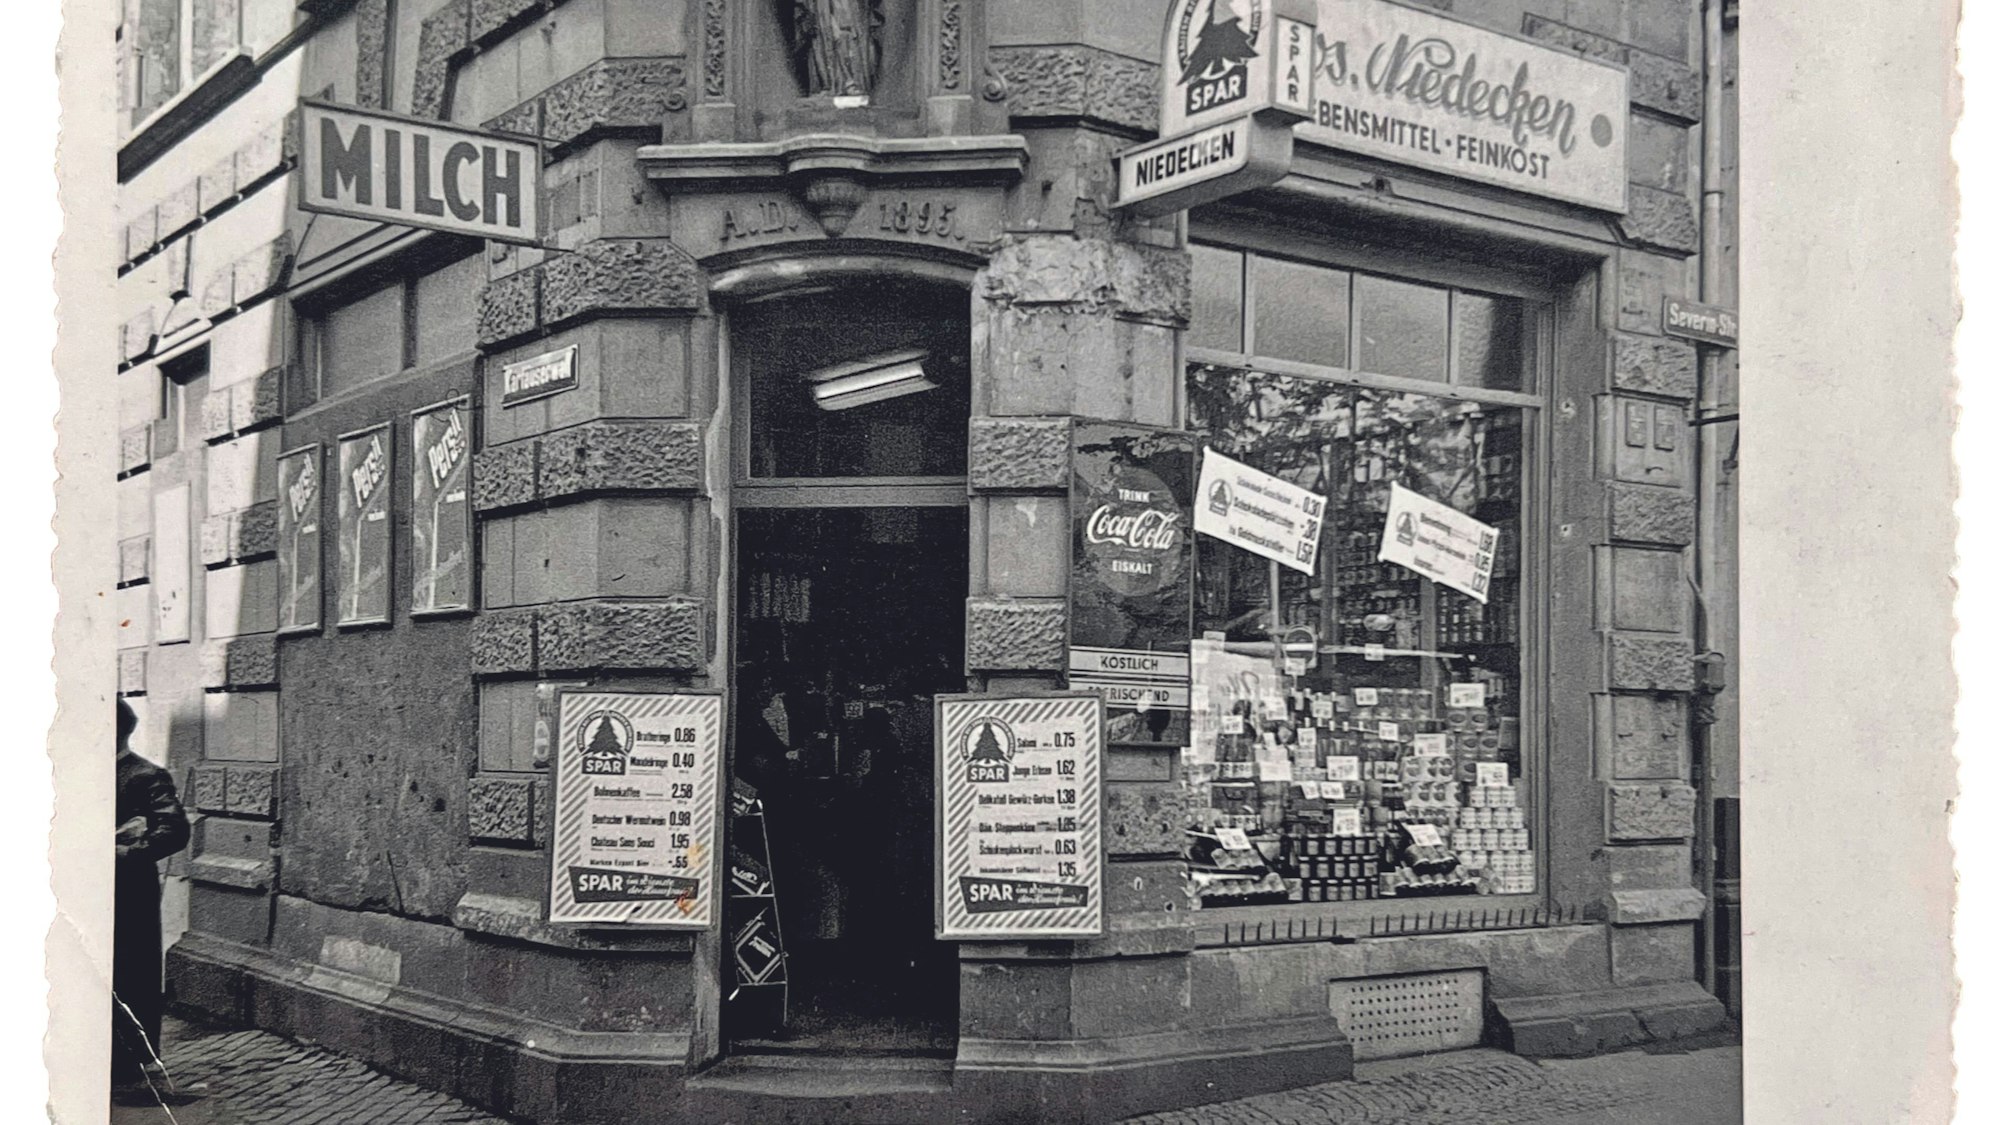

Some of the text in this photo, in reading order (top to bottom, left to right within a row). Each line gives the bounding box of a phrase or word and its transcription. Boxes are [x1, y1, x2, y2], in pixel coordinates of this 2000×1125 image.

[1287, 24, 1300, 103] SPAR
[1190, 74, 1241, 111] SPAR
[1366, 33, 1576, 158] Niedecken
[1313, 100, 1550, 179] BENSMITTEL FEINKOST
[1136, 131, 1235, 187] NIEDECKEN
[321, 117, 520, 228] MILCH
[1119, 488, 1150, 503] TRINK
[1112, 560, 1152, 576] EISKALT
[675, 727, 696, 743] 0.86
[1054, 732, 1076, 748] 0.75
[586, 759, 622, 773] SPAR
[672, 752, 695, 768] 0.40
[1056, 759, 1076, 776] 1.62
[970, 767, 1006, 781] SPAR
[671, 782, 694, 799] 2.58
[1057, 788, 1076, 804] 1.38
[669, 810, 692, 826] 0.98
[671, 832, 690, 849] 1.95
[1055, 838, 1076, 855] 0.63
[1057, 861, 1077, 877] 1.35
[578, 874, 623, 892] SPAR
[969, 883, 1014, 902] SPAR
